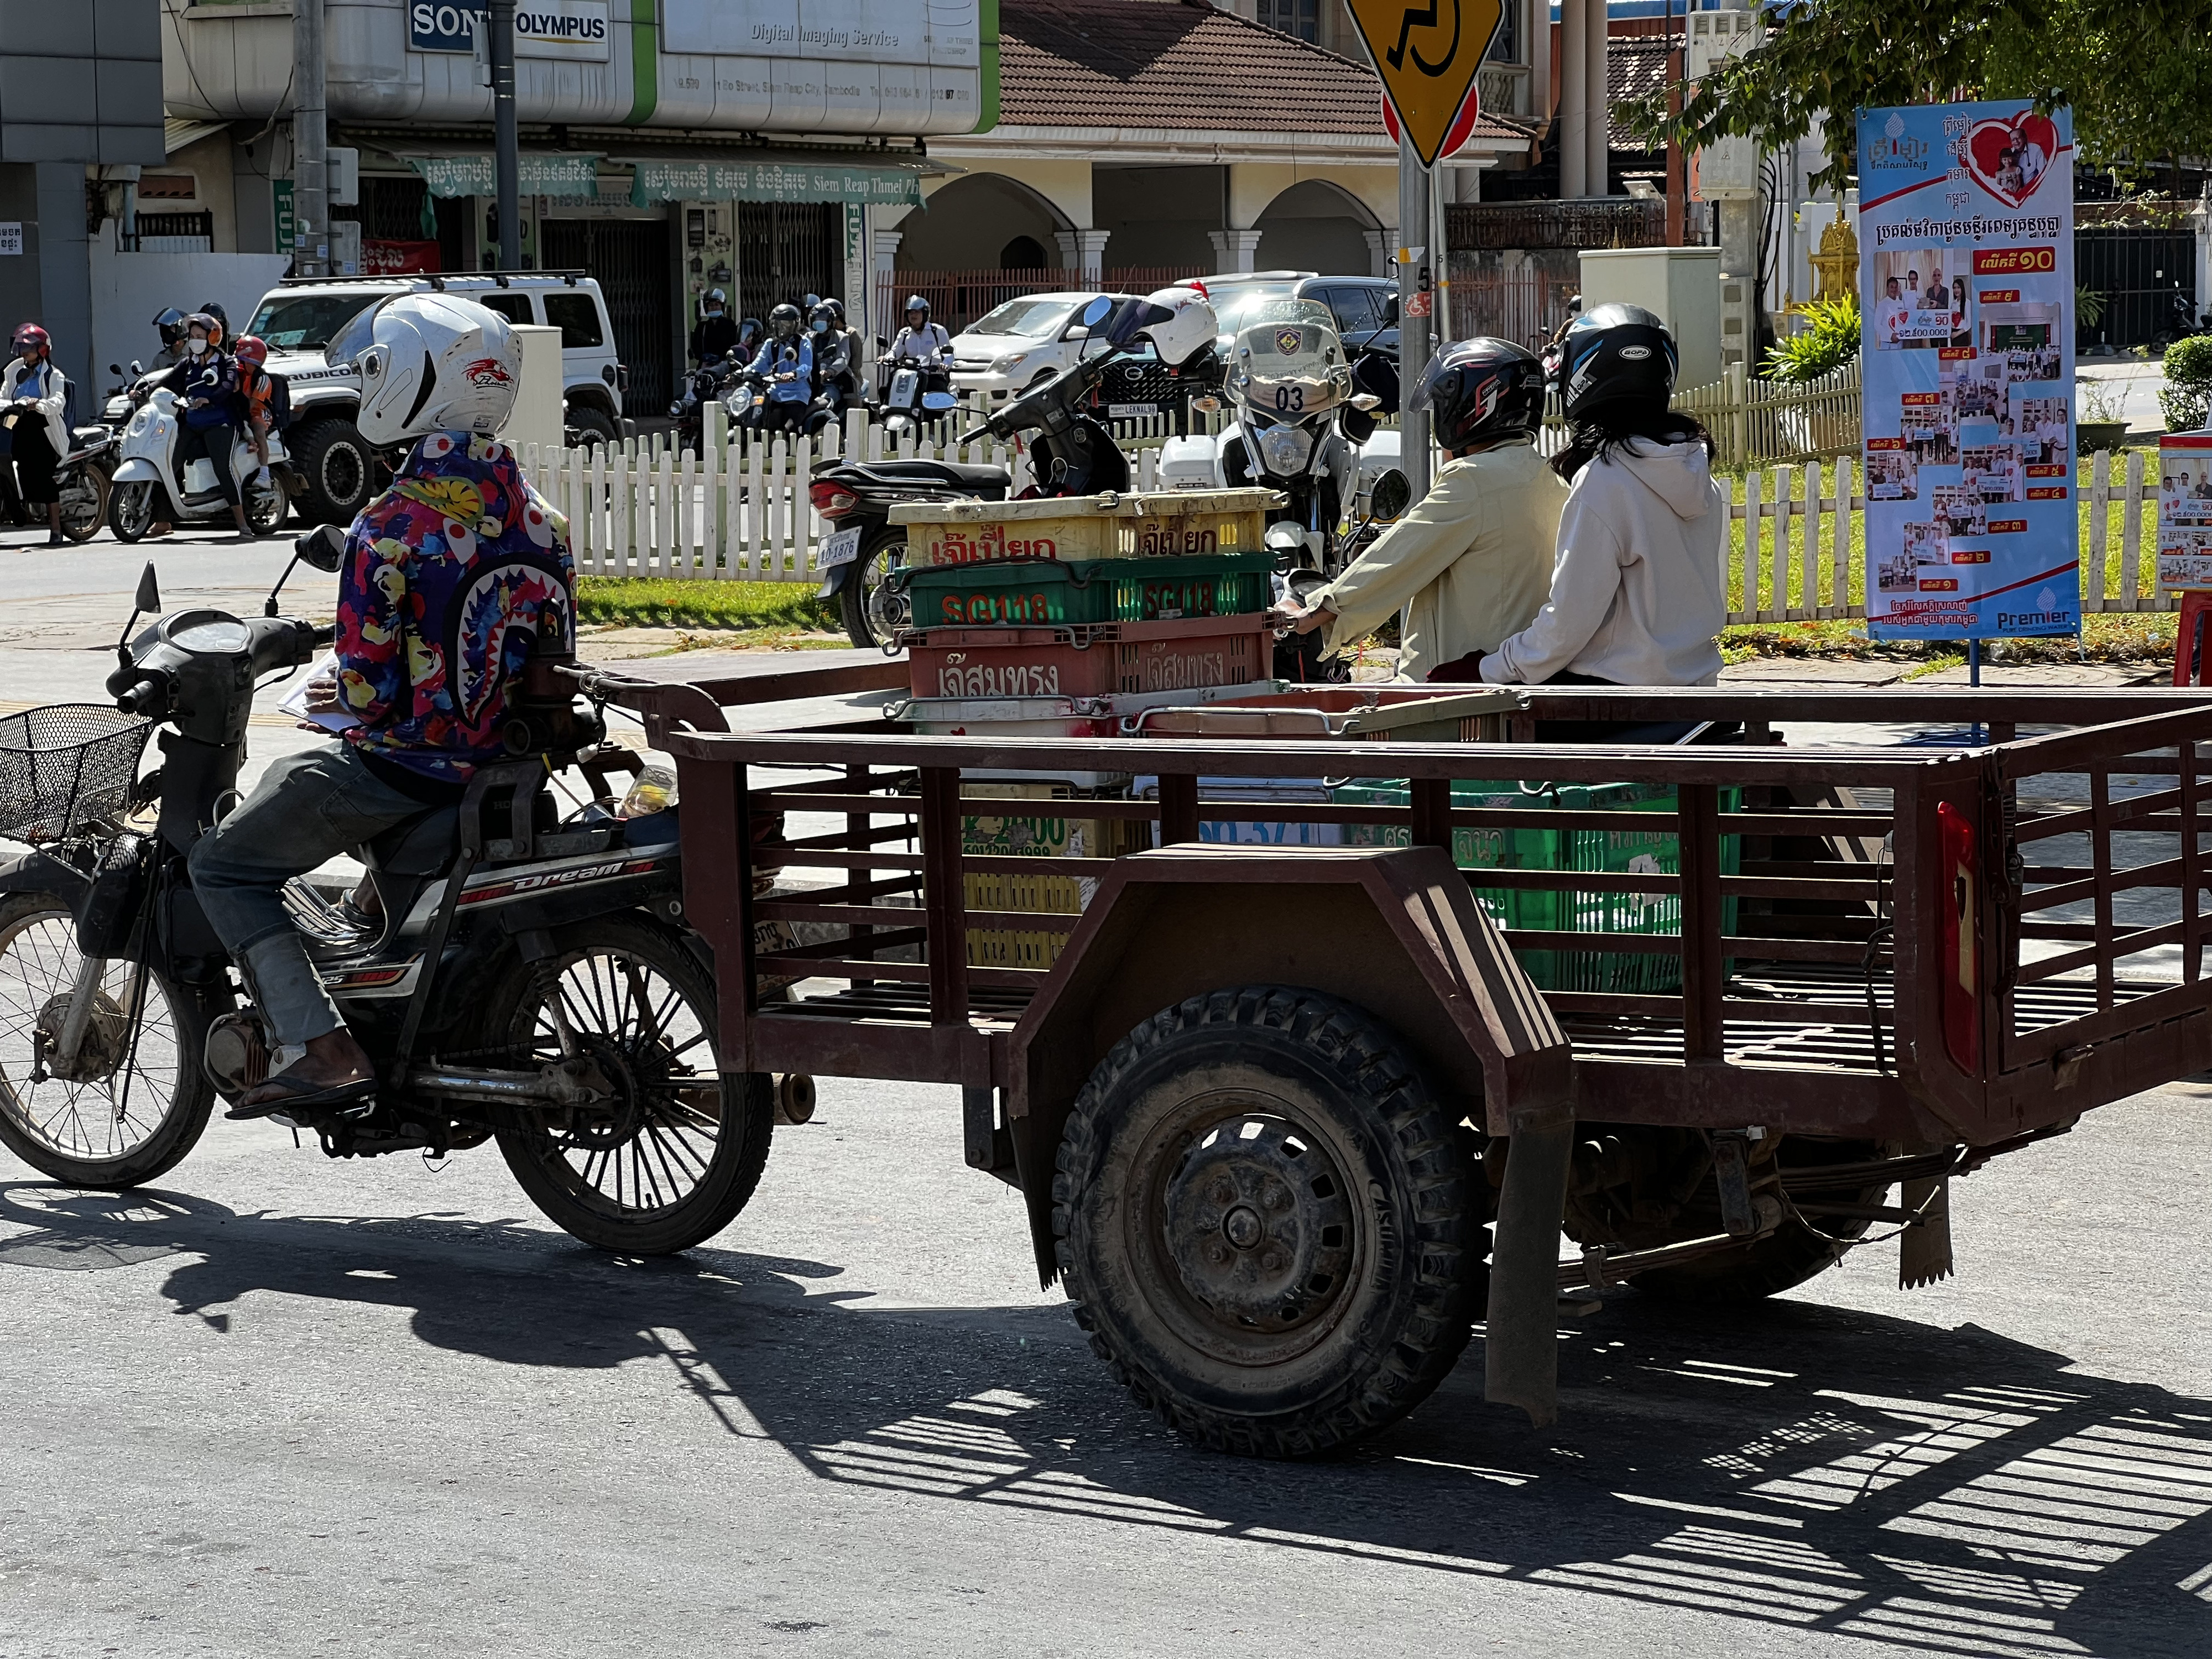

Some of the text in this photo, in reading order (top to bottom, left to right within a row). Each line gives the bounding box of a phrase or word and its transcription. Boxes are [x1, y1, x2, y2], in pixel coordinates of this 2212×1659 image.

[414, 4, 491, 36] SON
[516, 12, 604, 39] OLYMPUS
[752, 23, 899, 48] Digital Imaging Service
[825, 85, 860, 96] ambodia
[814, 175, 839, 192] Siem
[844, 177, 869, 196] Reap
[871, 178, 902, 194] Thmei
[906, 178, 920, 194] Ph
[2020, 251, 2053, 269] ១០
[1417, 267, 1430, 292] 5
[286, 369, 351, 382] RUBICO
[1276, 386, 1303, 412] 03
[942, 593, 1048, 625] SG118
[1145, 582, 1214, 618] SG118
[940, 653, 1059, 697] เจ๊สมทรง
[513, 862, 624, 891] Dream
